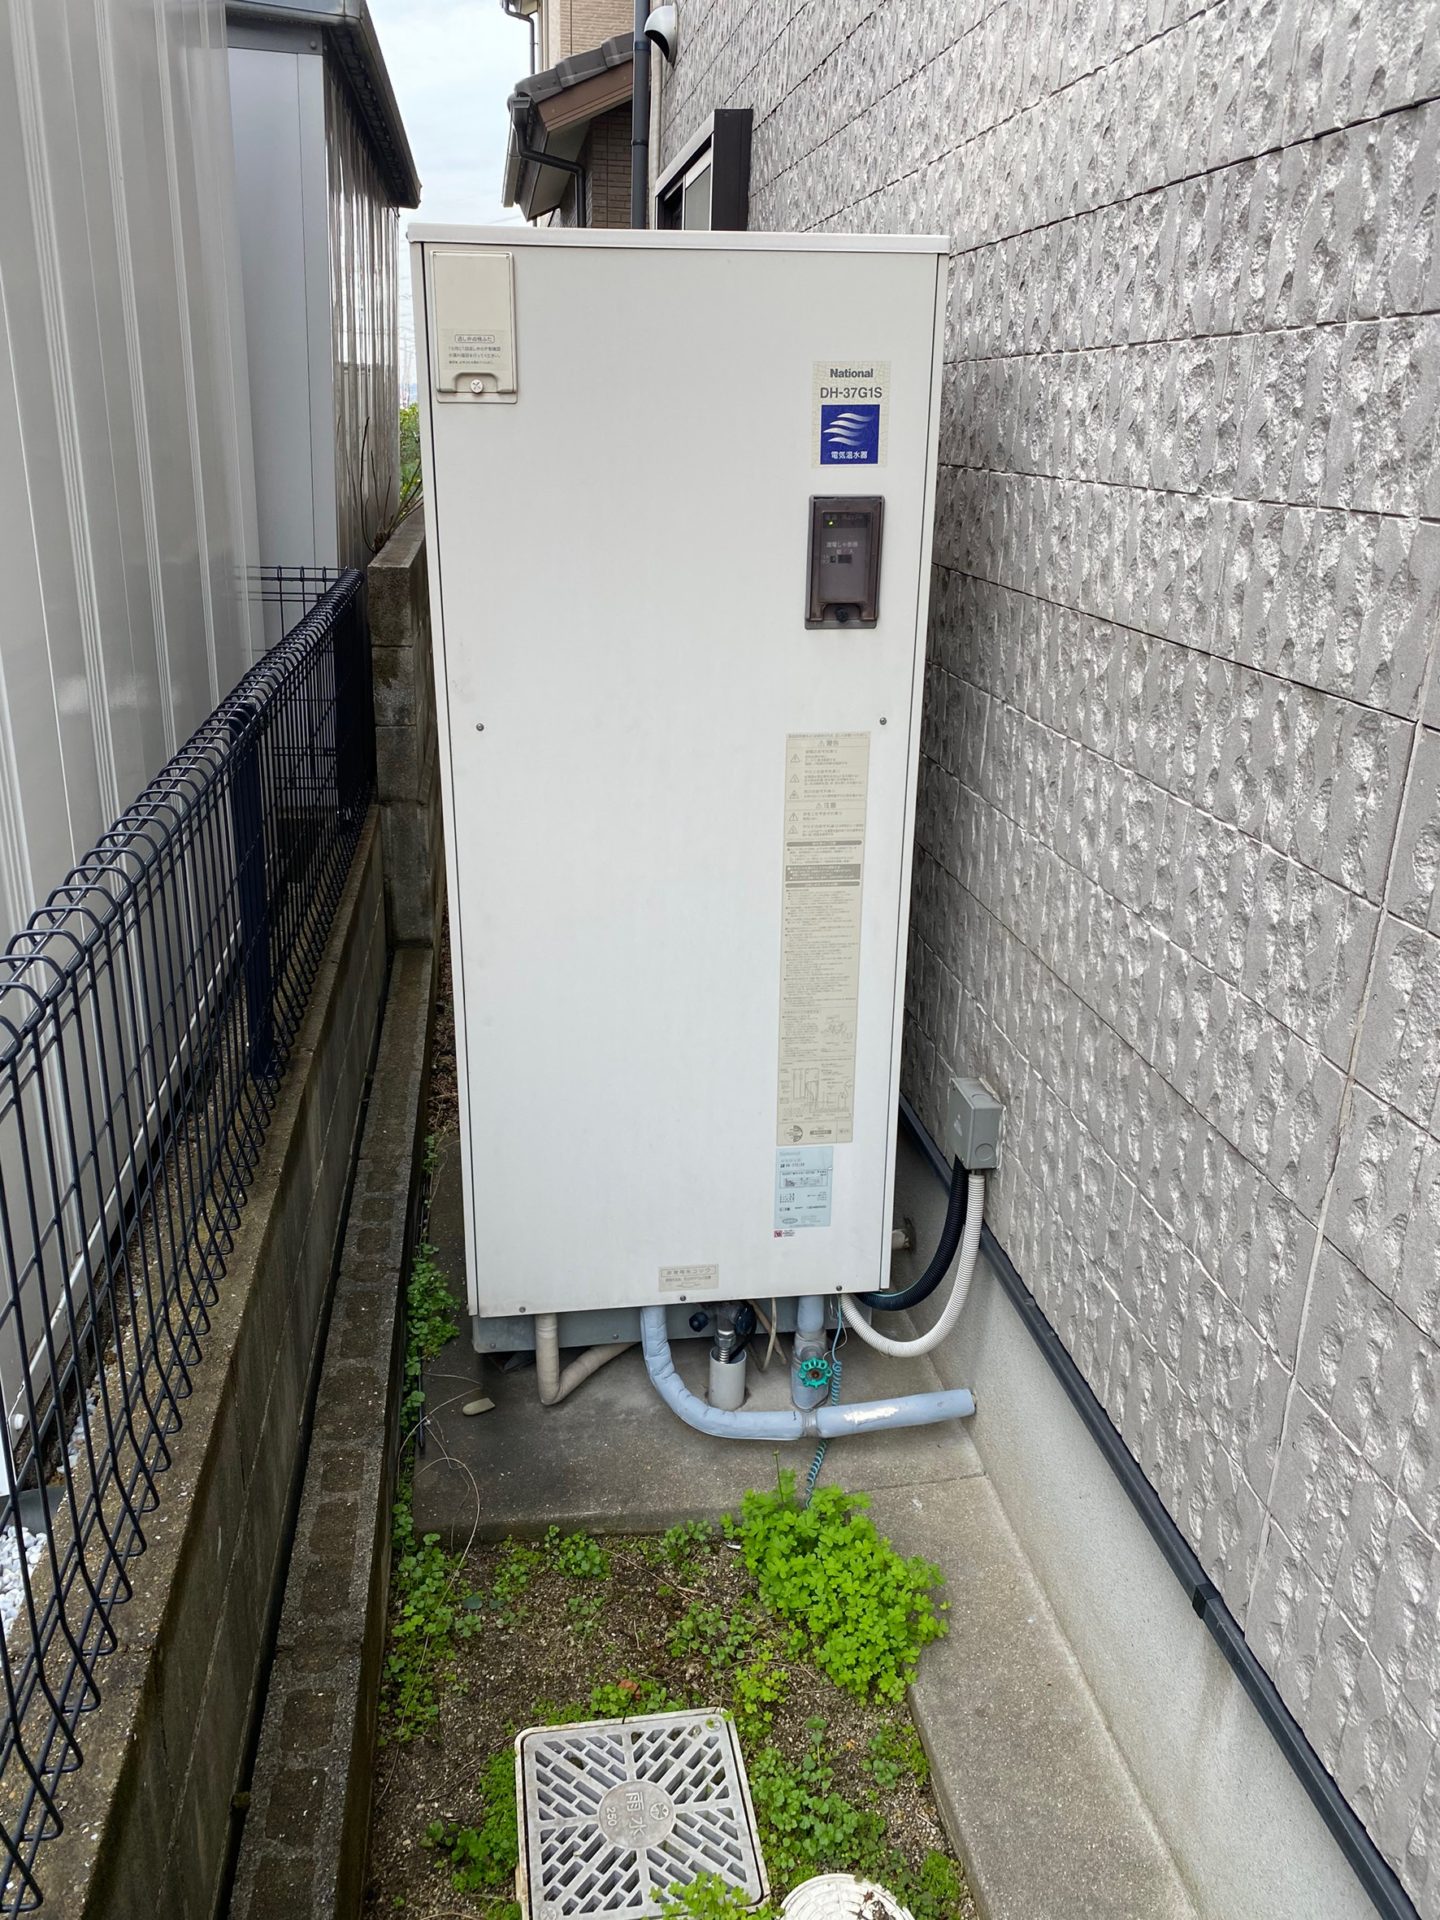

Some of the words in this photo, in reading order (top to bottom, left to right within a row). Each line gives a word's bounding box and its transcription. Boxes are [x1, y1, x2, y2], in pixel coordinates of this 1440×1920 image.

[829, 368, 874, 378] National
[820, 386, 883, 399] DH-37G1S
[831, 451, 868, 460] 電気温水器
[606, 1806, 618, 1827] 250
[625, 1791, 648, 1840] 雨水
